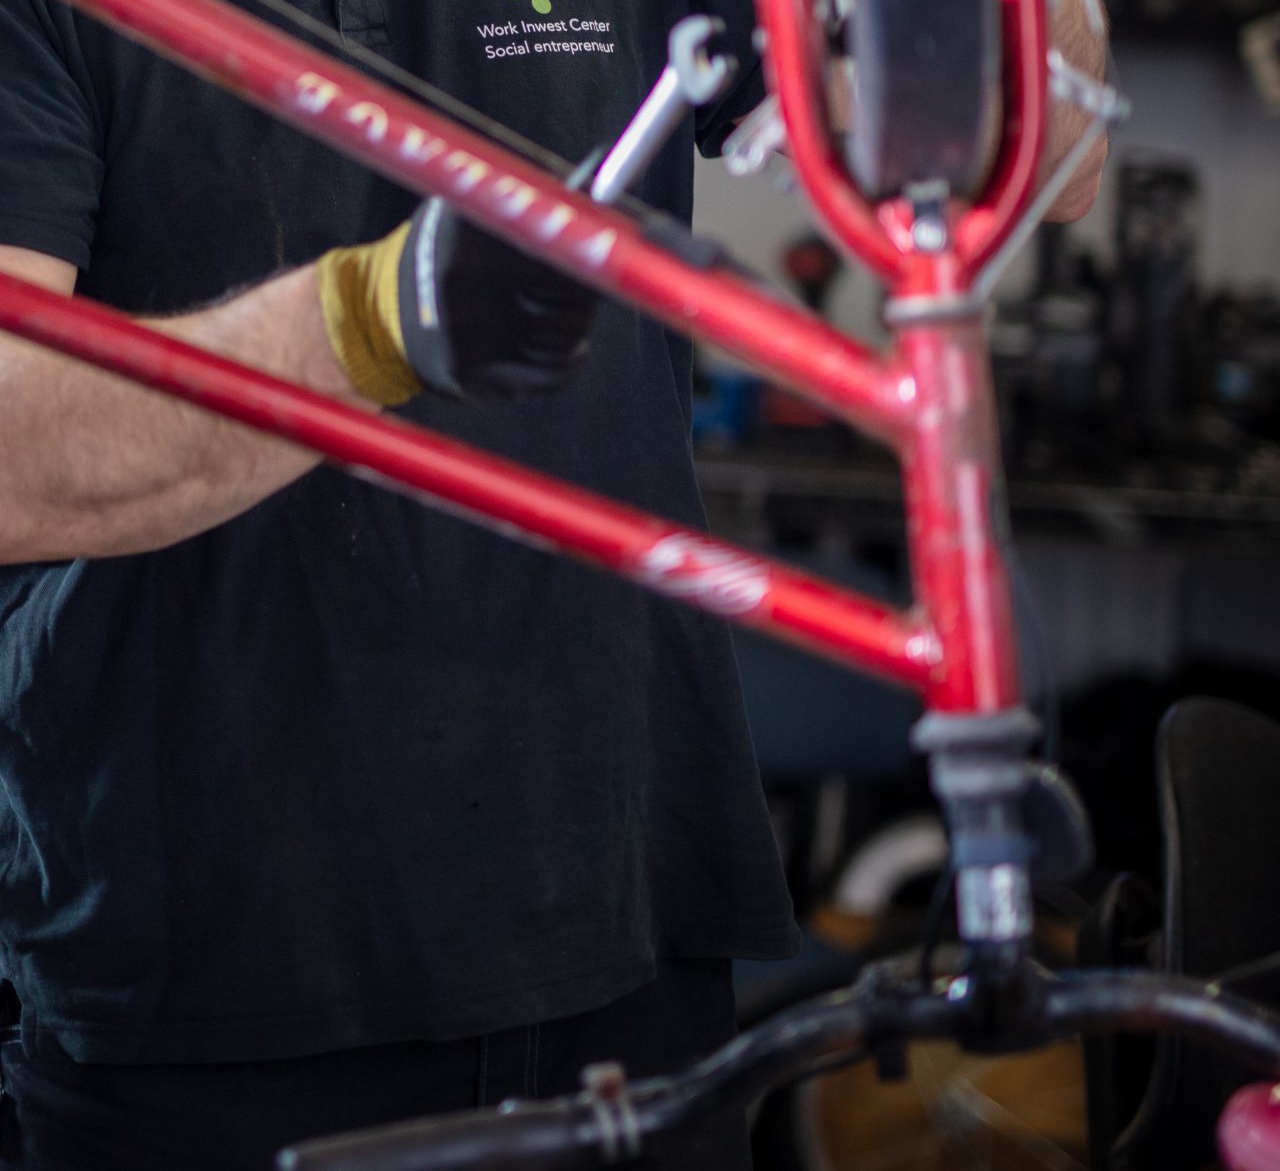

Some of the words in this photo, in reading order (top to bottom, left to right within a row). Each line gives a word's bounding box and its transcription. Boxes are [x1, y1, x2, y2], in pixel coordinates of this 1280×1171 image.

[477, 21, 519, 39] Work
[569, 17, 611, 33] Center
[485, 40, 530, 59] Social
[534, 40, 615, 55] entrepreneur
